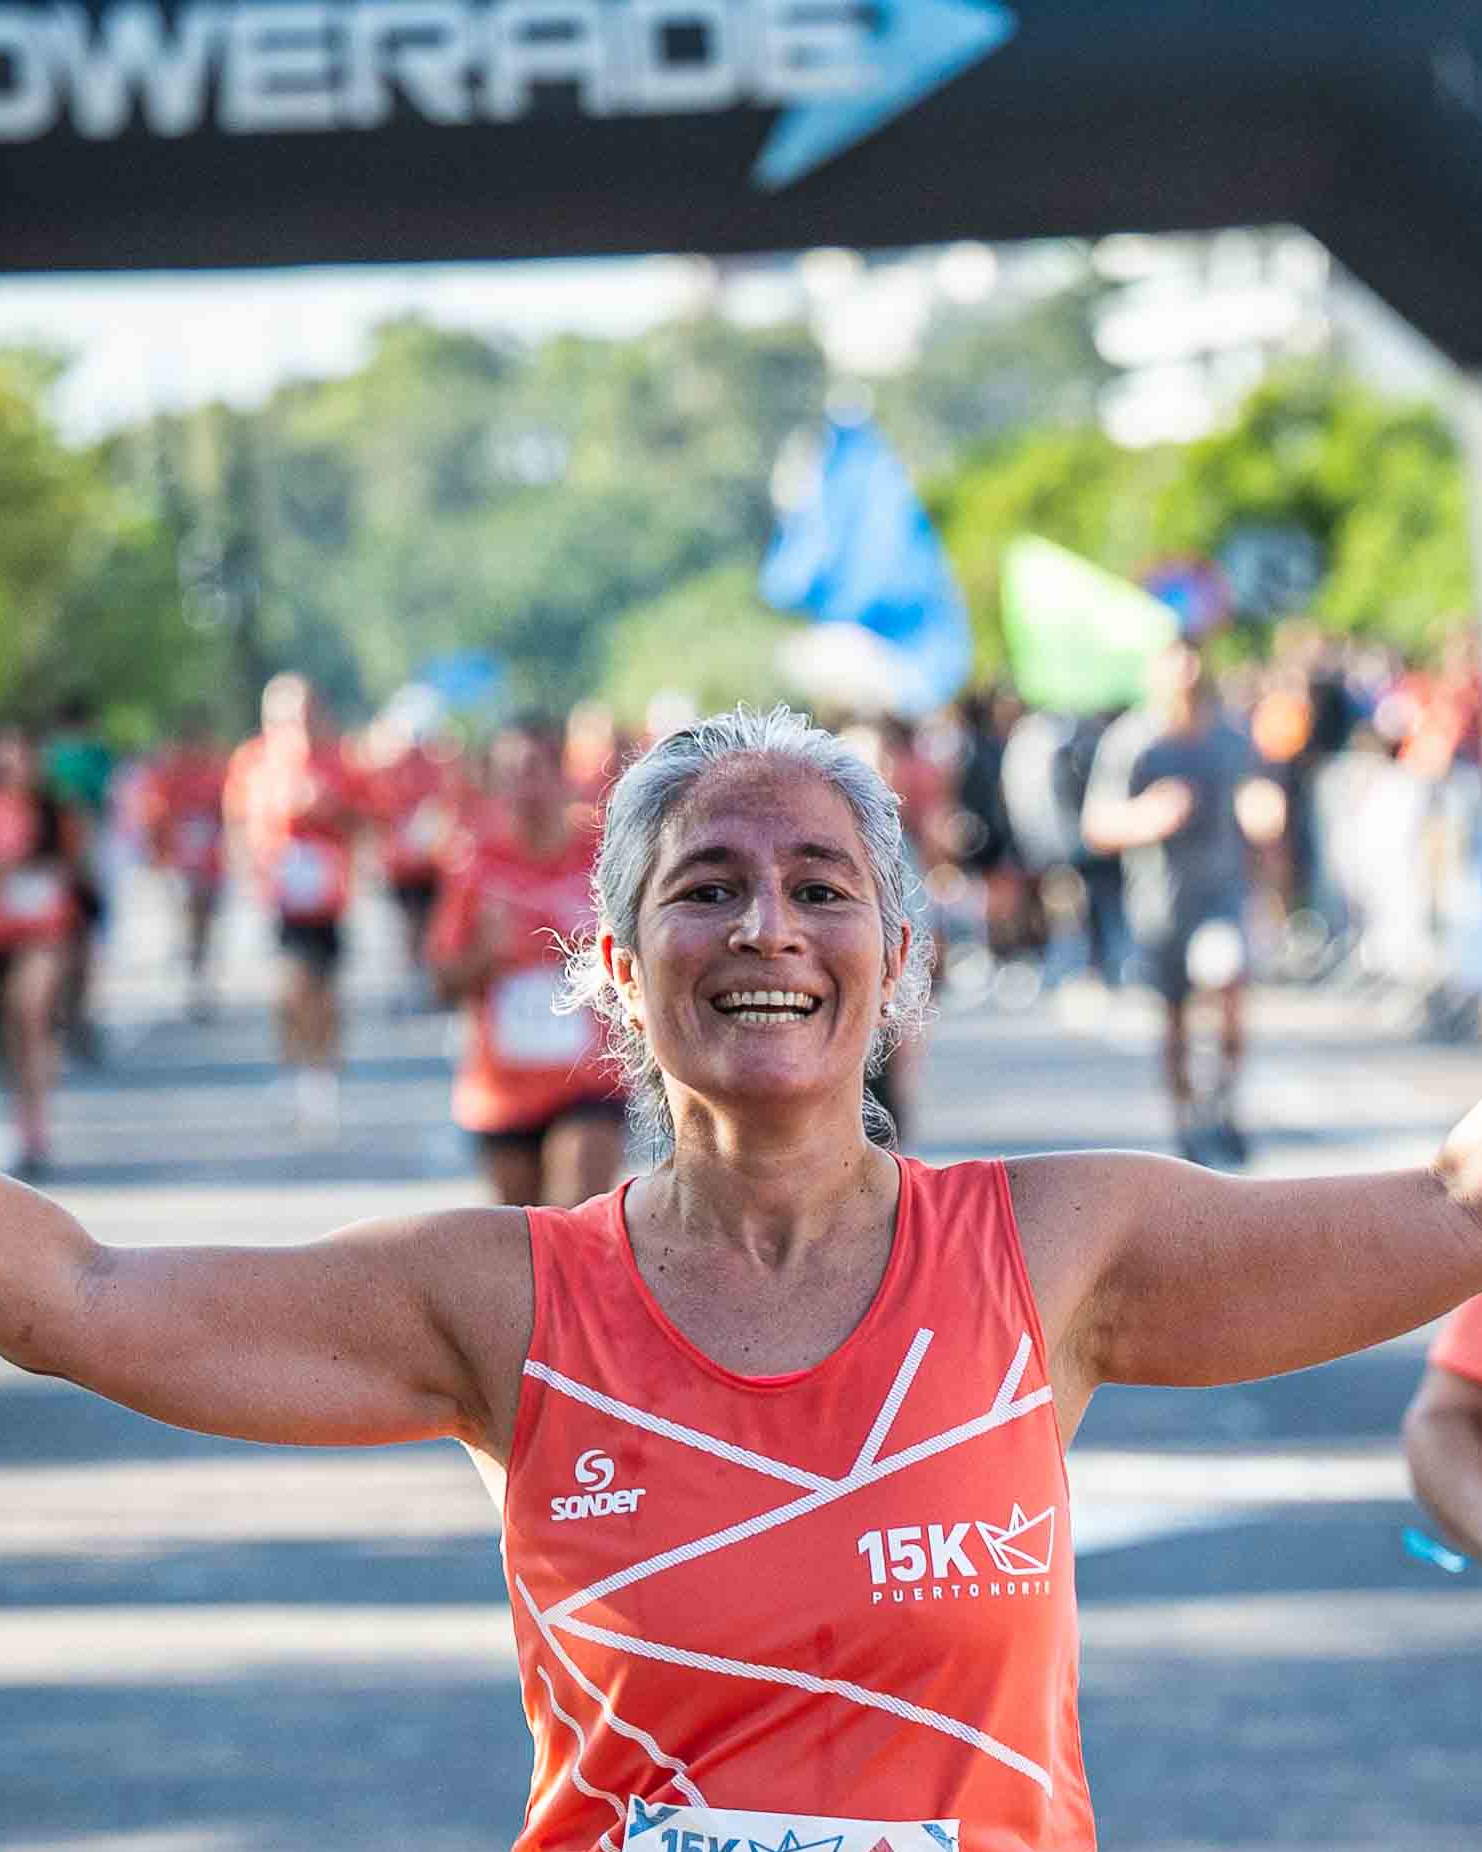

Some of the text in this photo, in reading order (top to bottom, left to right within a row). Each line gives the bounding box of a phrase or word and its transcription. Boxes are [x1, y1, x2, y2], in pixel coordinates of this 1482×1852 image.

[857, 1522, 979, 1585] 15K
[872, 1580, 1050, 1604] PUERTO NORTE
